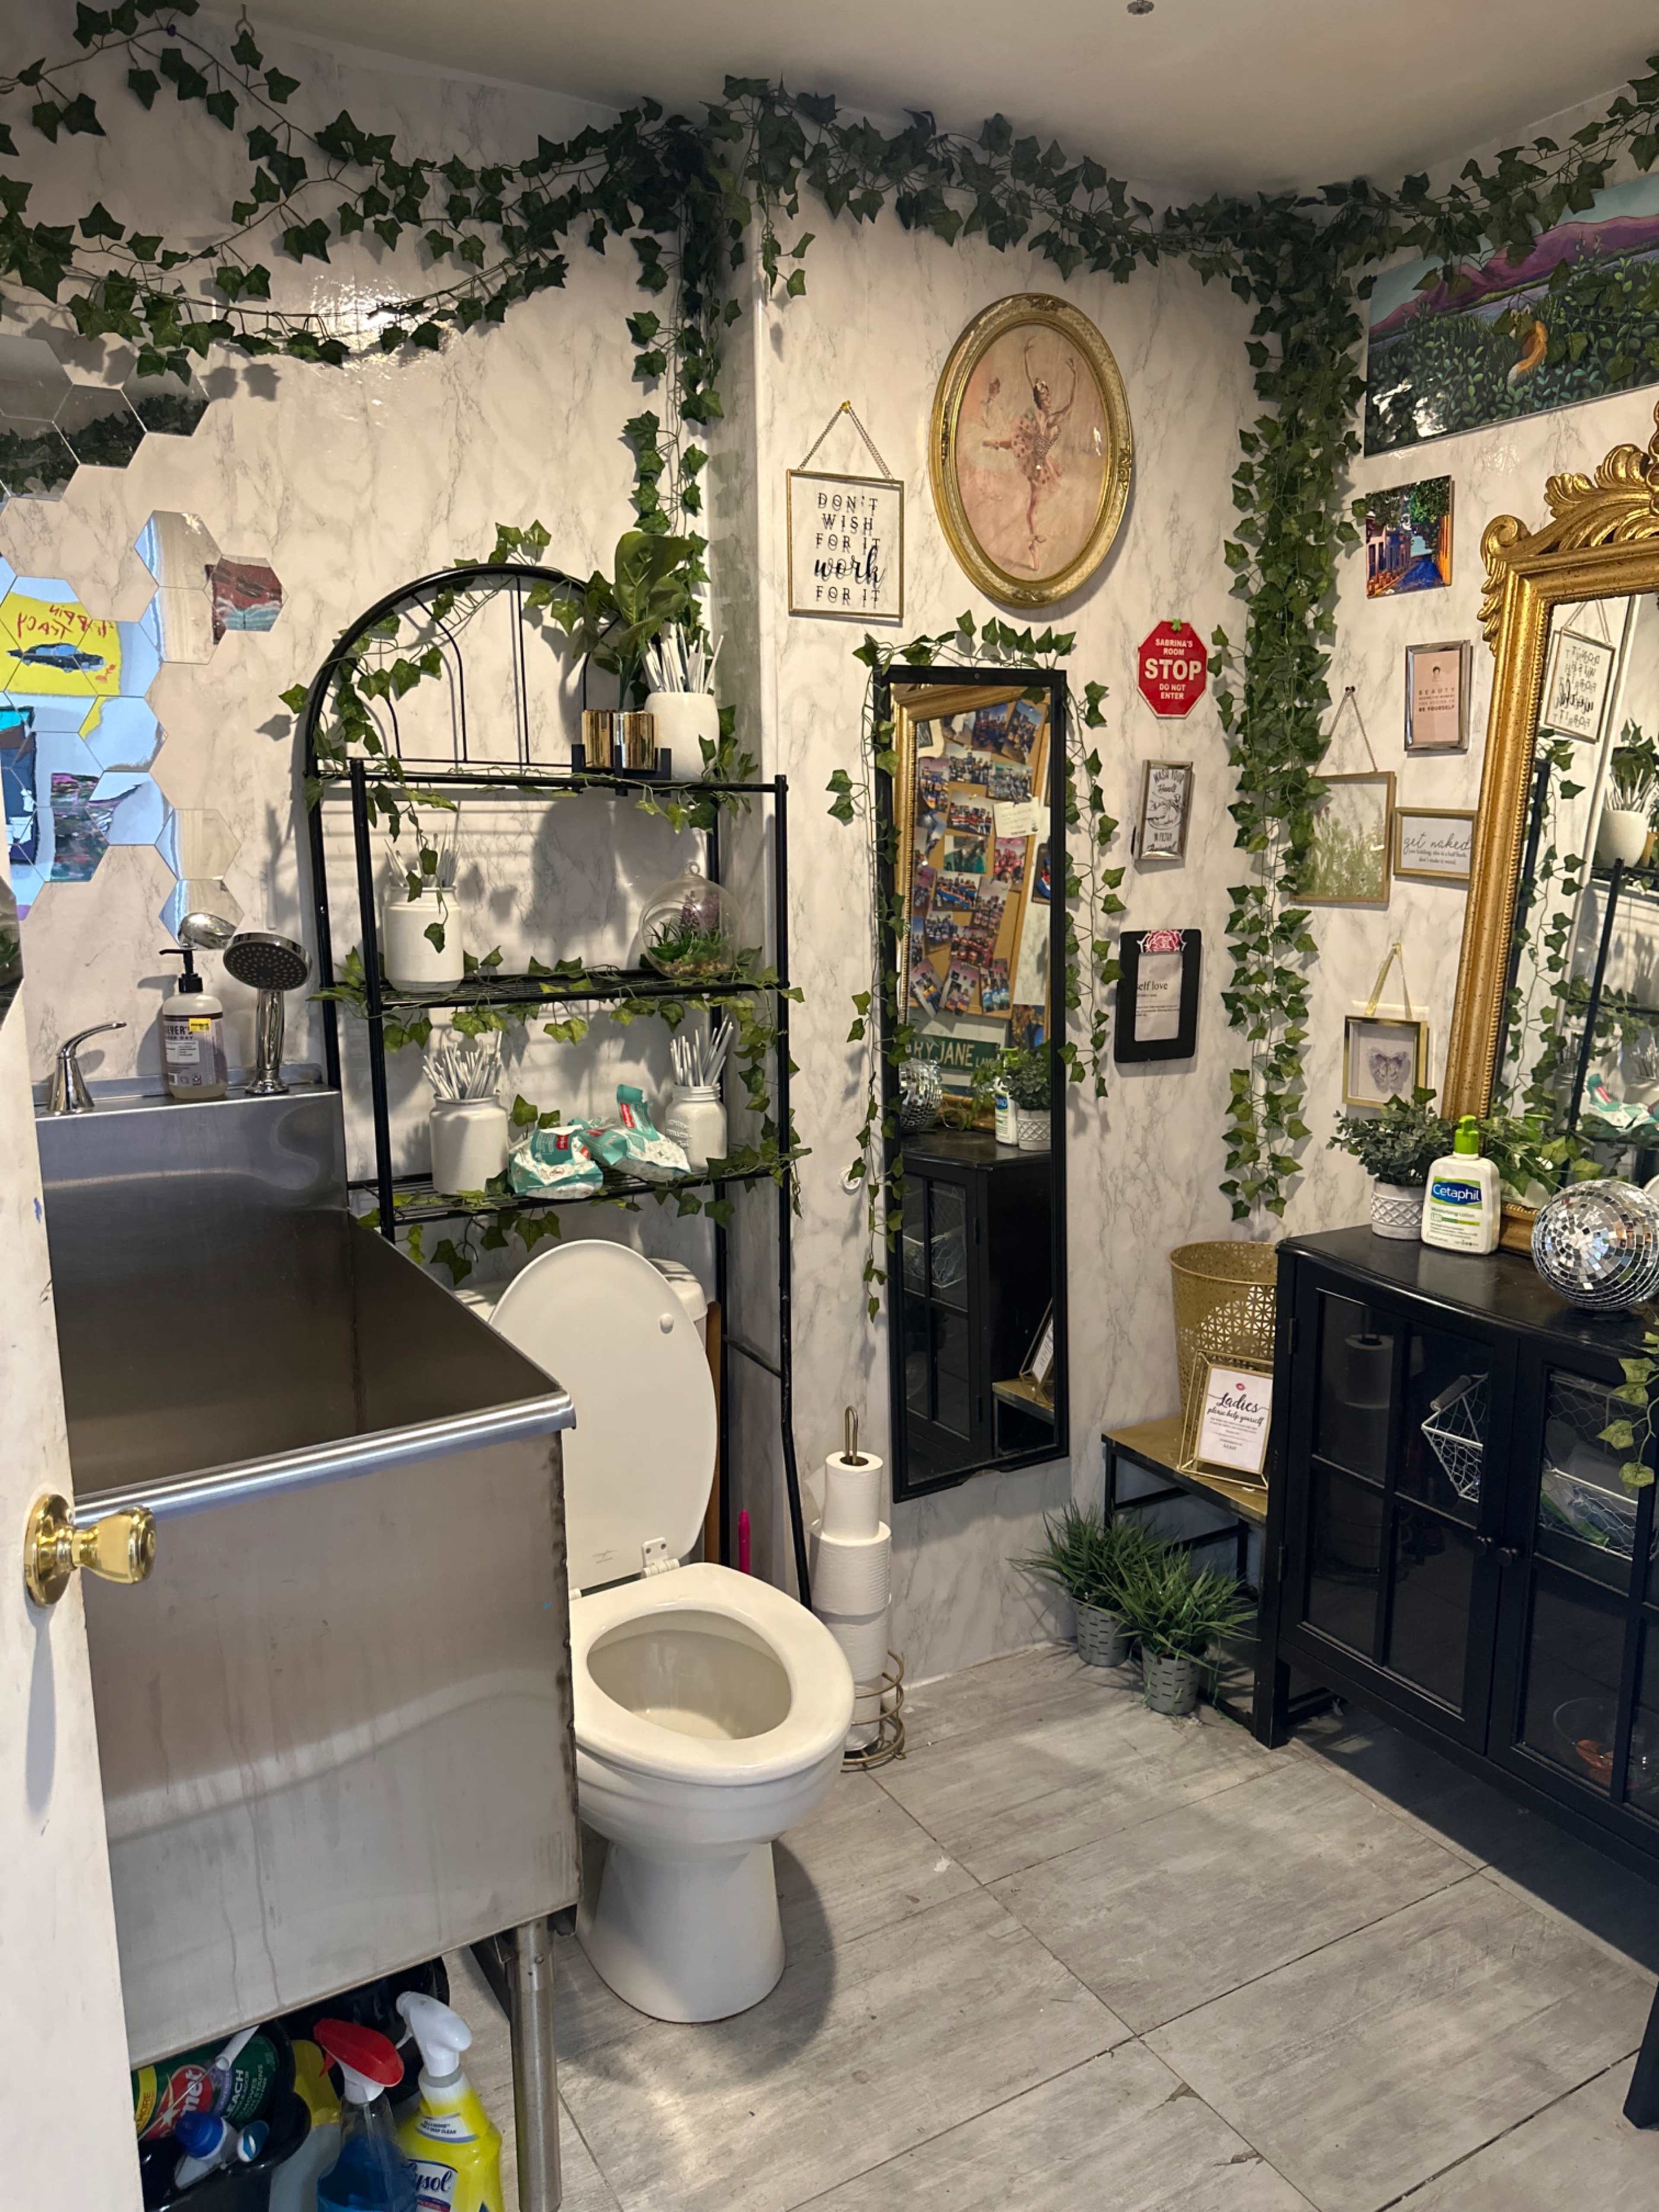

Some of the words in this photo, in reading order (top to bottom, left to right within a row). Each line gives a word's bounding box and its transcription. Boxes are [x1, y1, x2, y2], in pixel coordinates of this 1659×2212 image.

[818, 493, 878, 511] DON'T
[822, 513, 873, 530] WISH
[816, 533, 851, 547] FOR
[863, 537, 880, 550] IT
[815, 545, 886, 584] work
[816, 586, 851, 600] FOR
[863, 589, 880, 602] IT
[1155, 638, 1193, 648] SABRINA'S
[1144, 658, 1202, 681] STOP
[1403, 832, 1426, 855] get
[1430, 833, 1471, 850] naked
[1152, 981, 1168, 990] love
[936, 1041, 975, 1067] JANE
[1433, 1184, 1480, 1201] Cetaphil
[1214, 1392, 1260, 1413] Ladies
[1207, 1407, 1226, 1416] please
[1226, 1409, 1239, 1421] help
[1239, 1416, 1265, 1427] yourself
